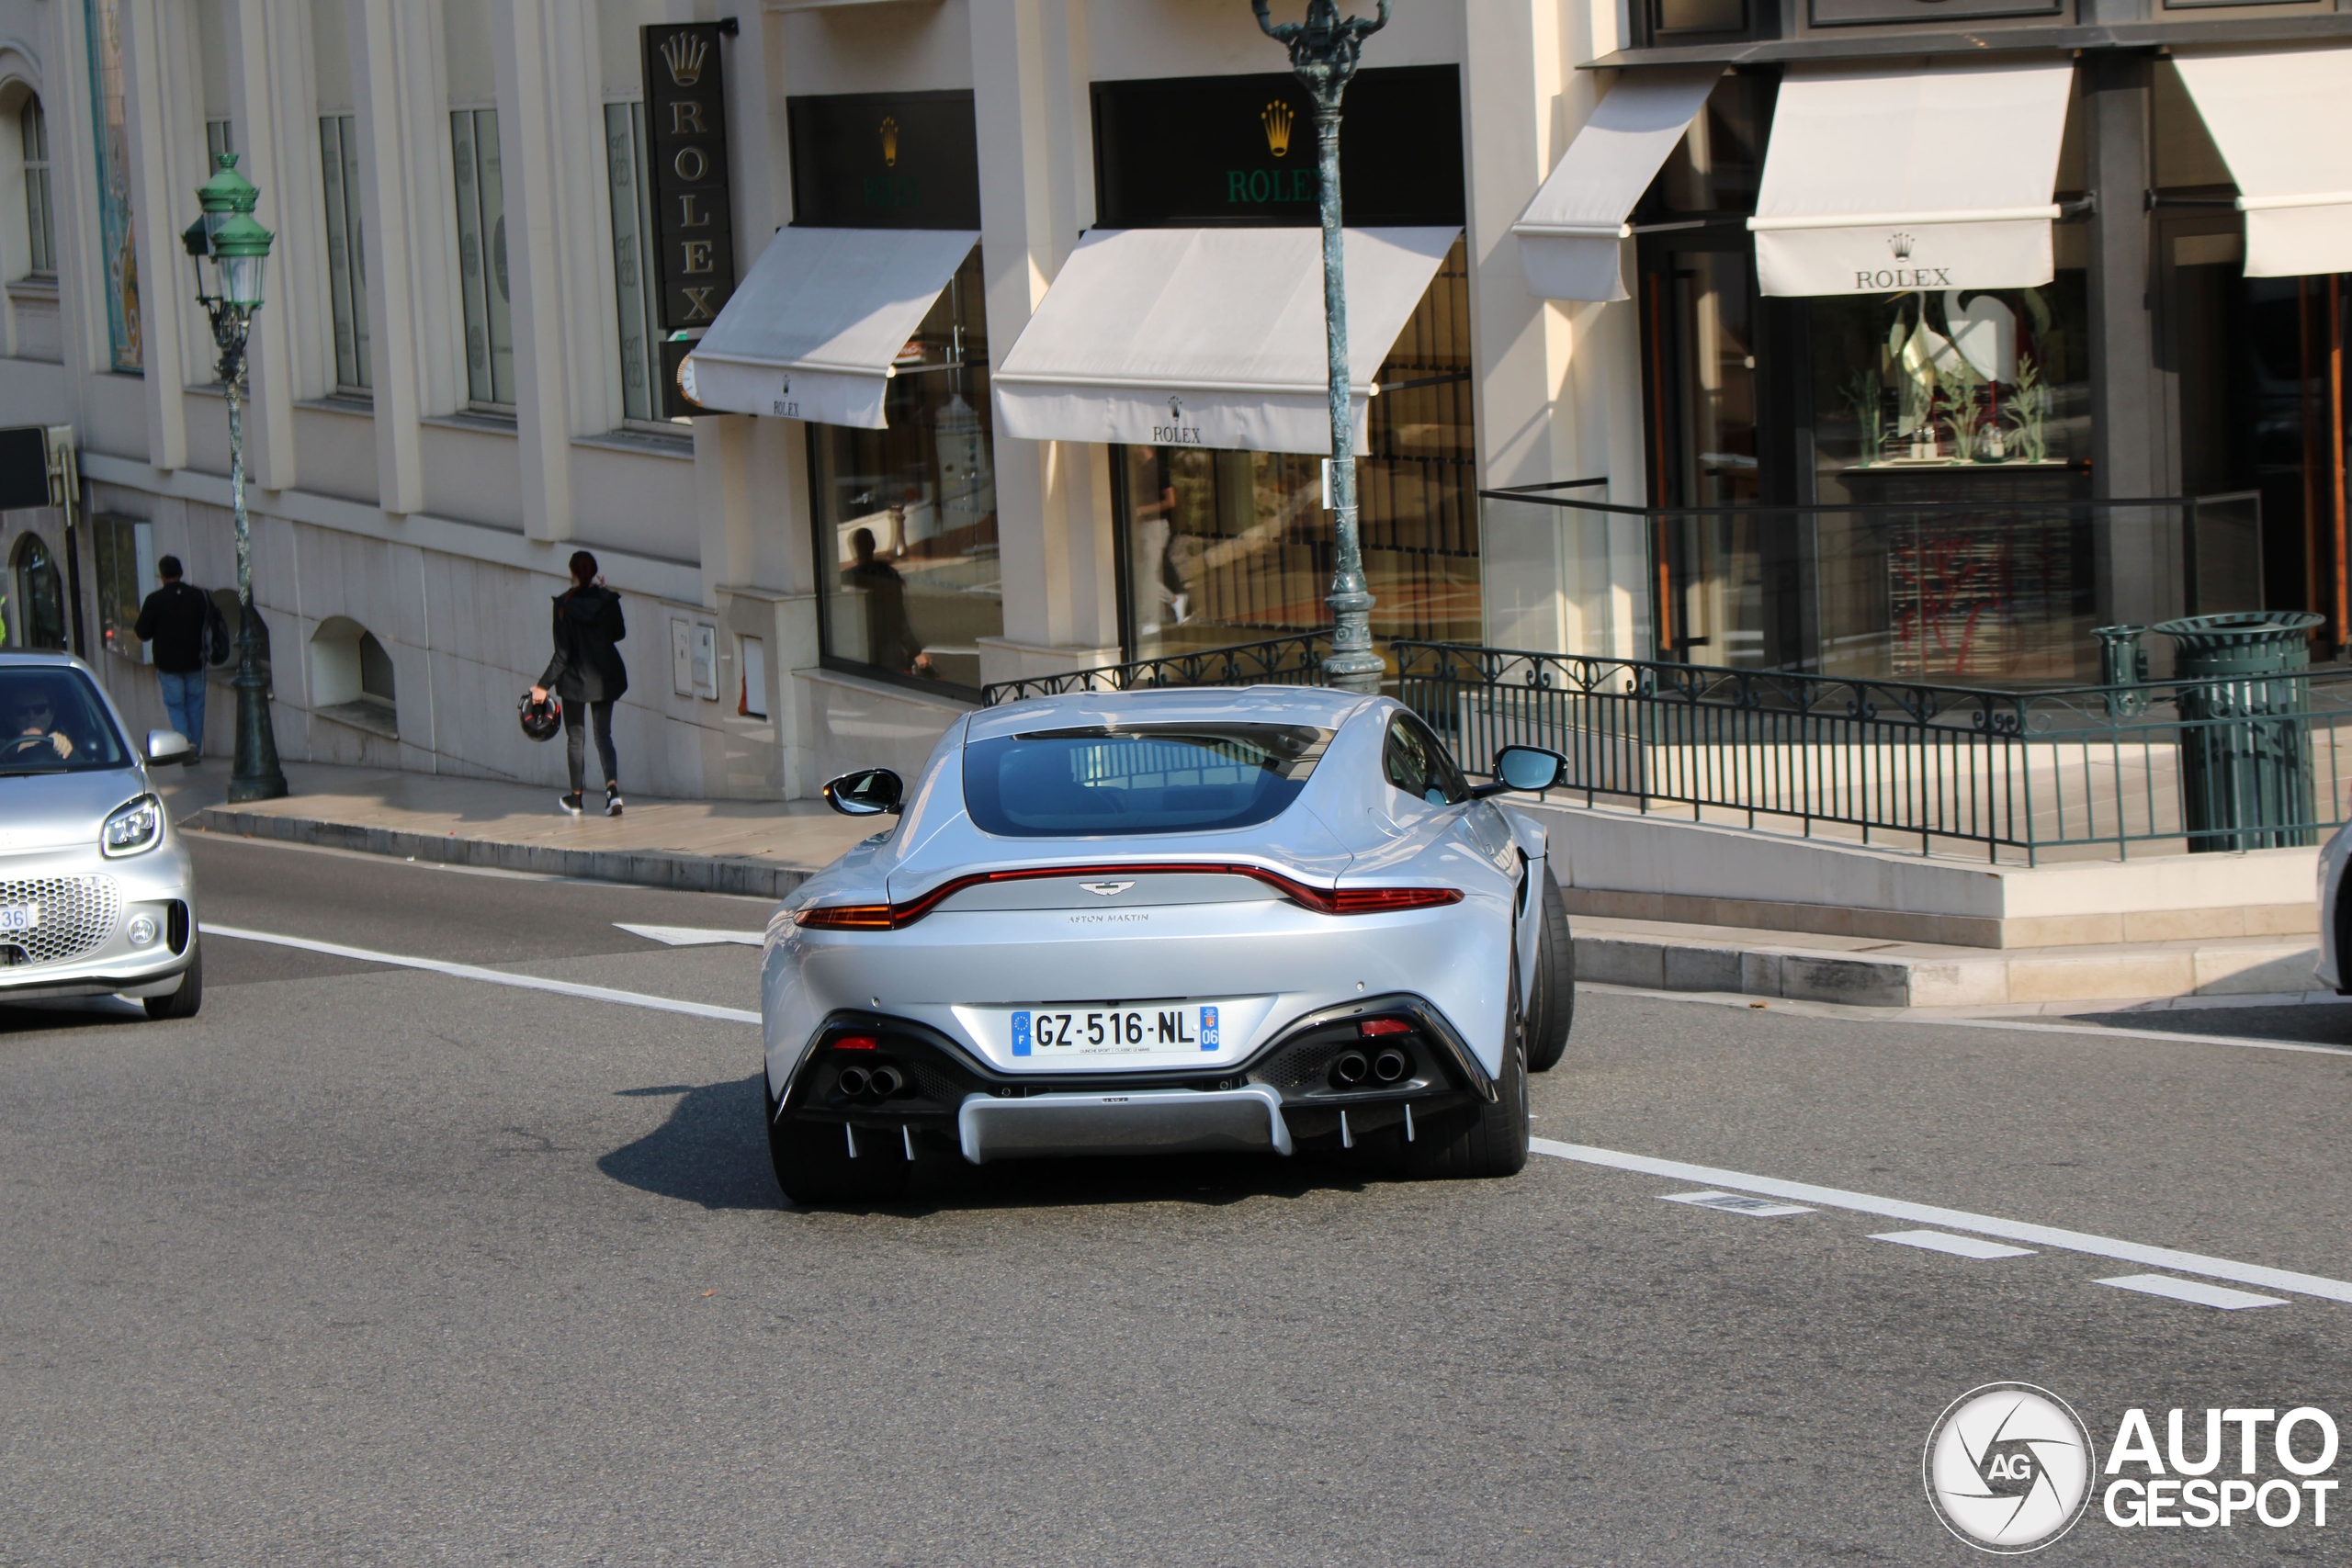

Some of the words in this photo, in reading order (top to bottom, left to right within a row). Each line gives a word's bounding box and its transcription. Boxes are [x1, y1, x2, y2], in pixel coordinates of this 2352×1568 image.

[670, 102, 716, 321] ROLEX
[1854, 268, 1953, 289] ROLEX
[774, 400, 799, 418] ROLEX
[1152, 426, 1201, 444] ROLEX
[1068, 915, 1103, 923] ASTON
[1107, 913, 1149, 922] MARTIN
[1035, 1011, 1195, 1047] GZ-516-NL
[1202, 1029, 1218, 1044] 06
[1018, 1034, 1024, 1045] F
